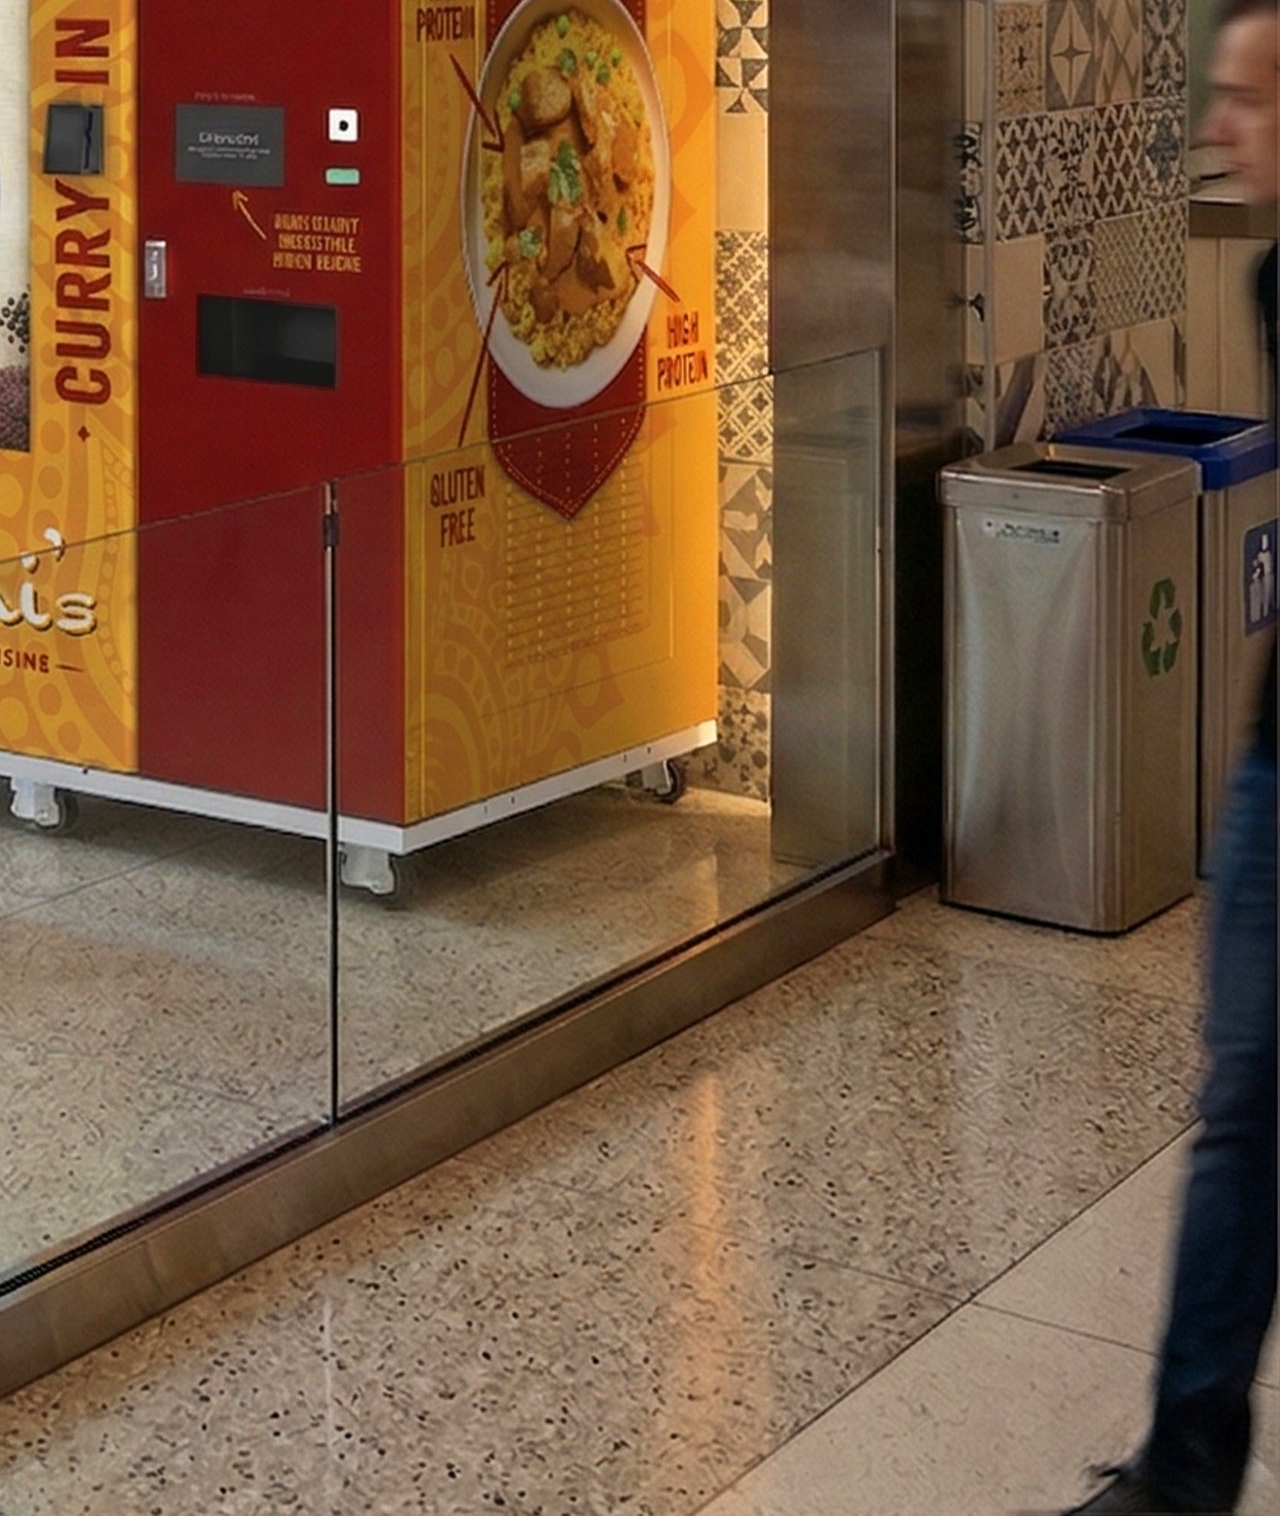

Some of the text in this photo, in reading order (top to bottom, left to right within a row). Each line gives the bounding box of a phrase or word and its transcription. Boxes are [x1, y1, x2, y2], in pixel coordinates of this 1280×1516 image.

[54, 18, 110, 86] IN
[54, 179, 112, 406] CURRY
[430, 465, 486, 508] GLUTEN
[440, 507, 476, 548] FREE
